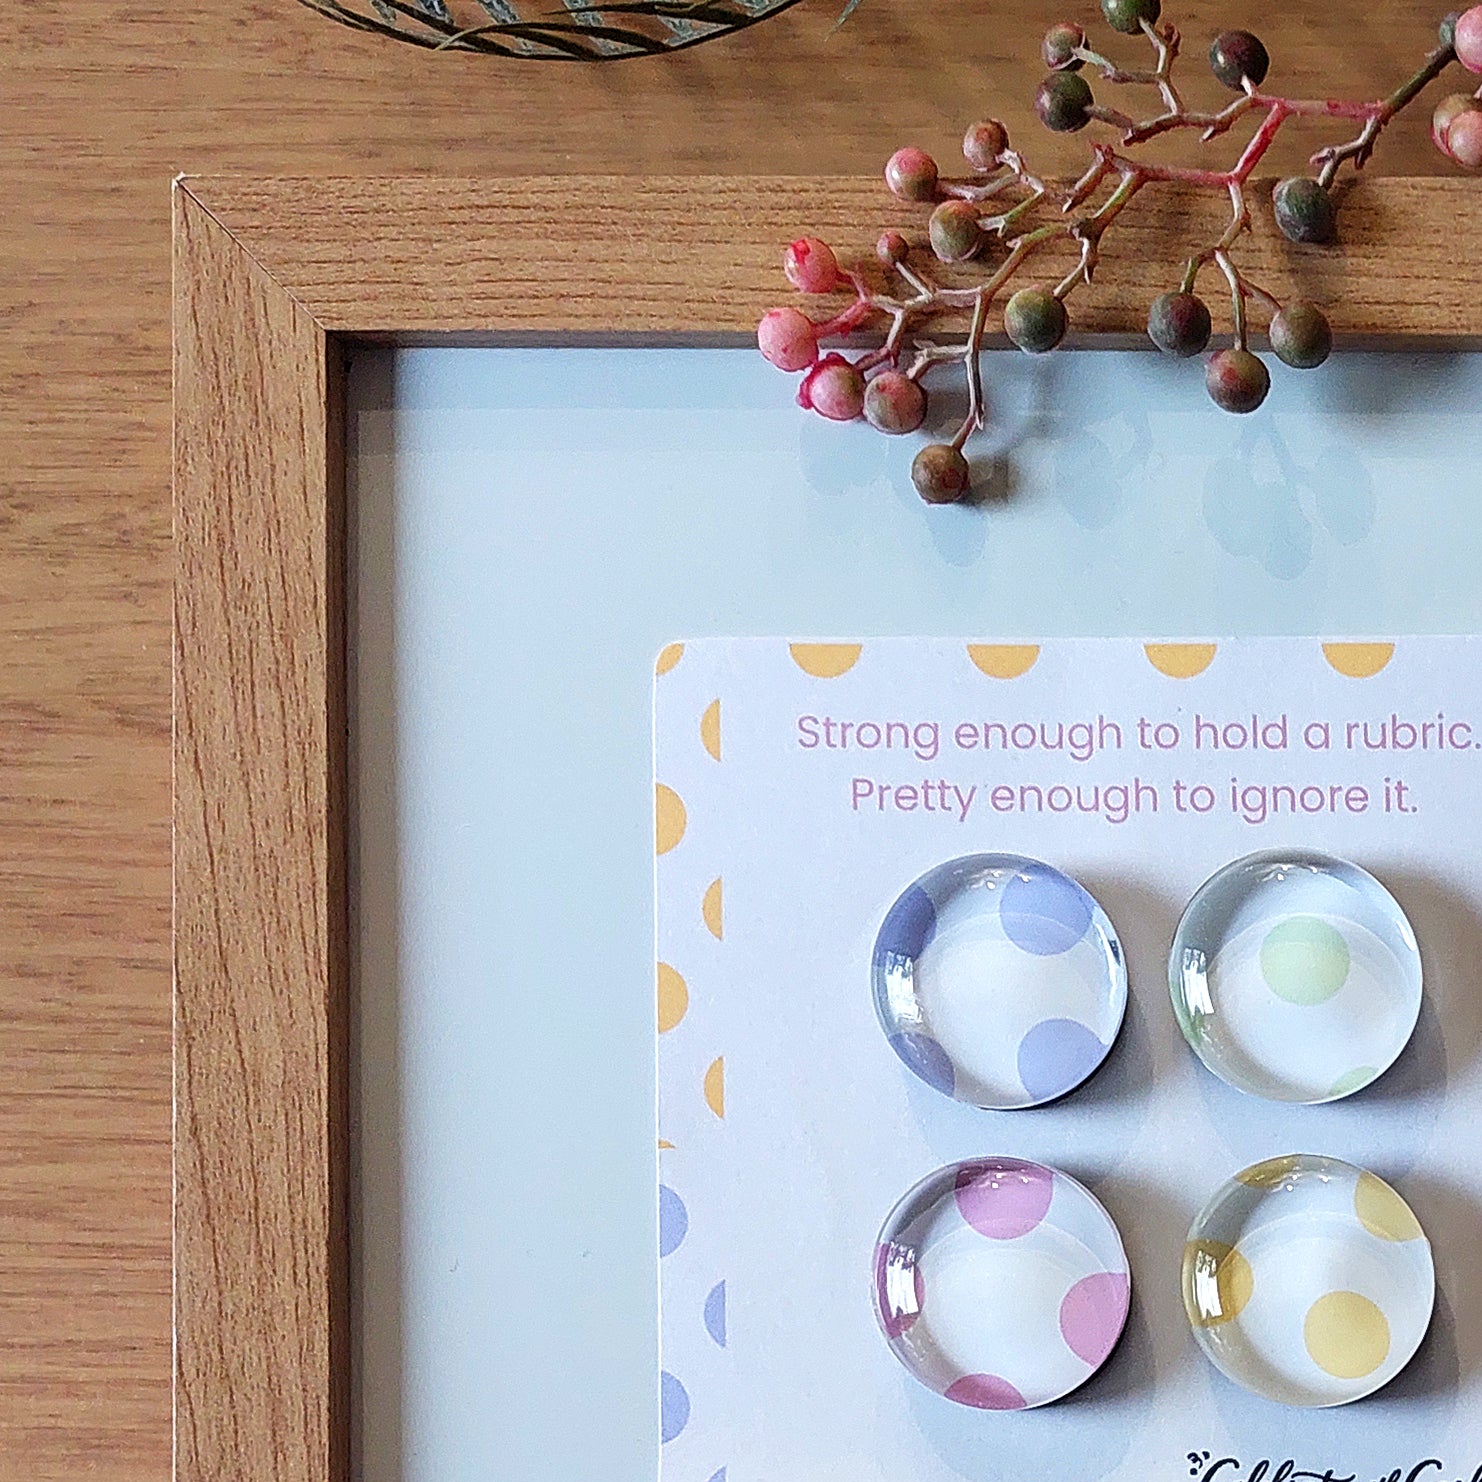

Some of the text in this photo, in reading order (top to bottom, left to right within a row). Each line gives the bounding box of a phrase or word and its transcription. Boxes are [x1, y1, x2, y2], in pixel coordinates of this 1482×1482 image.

[797, 714, 1482, 761] Strong enough to hold a rubric.
[851, 777, 1419, 824] Pretty enough to ignore it.
